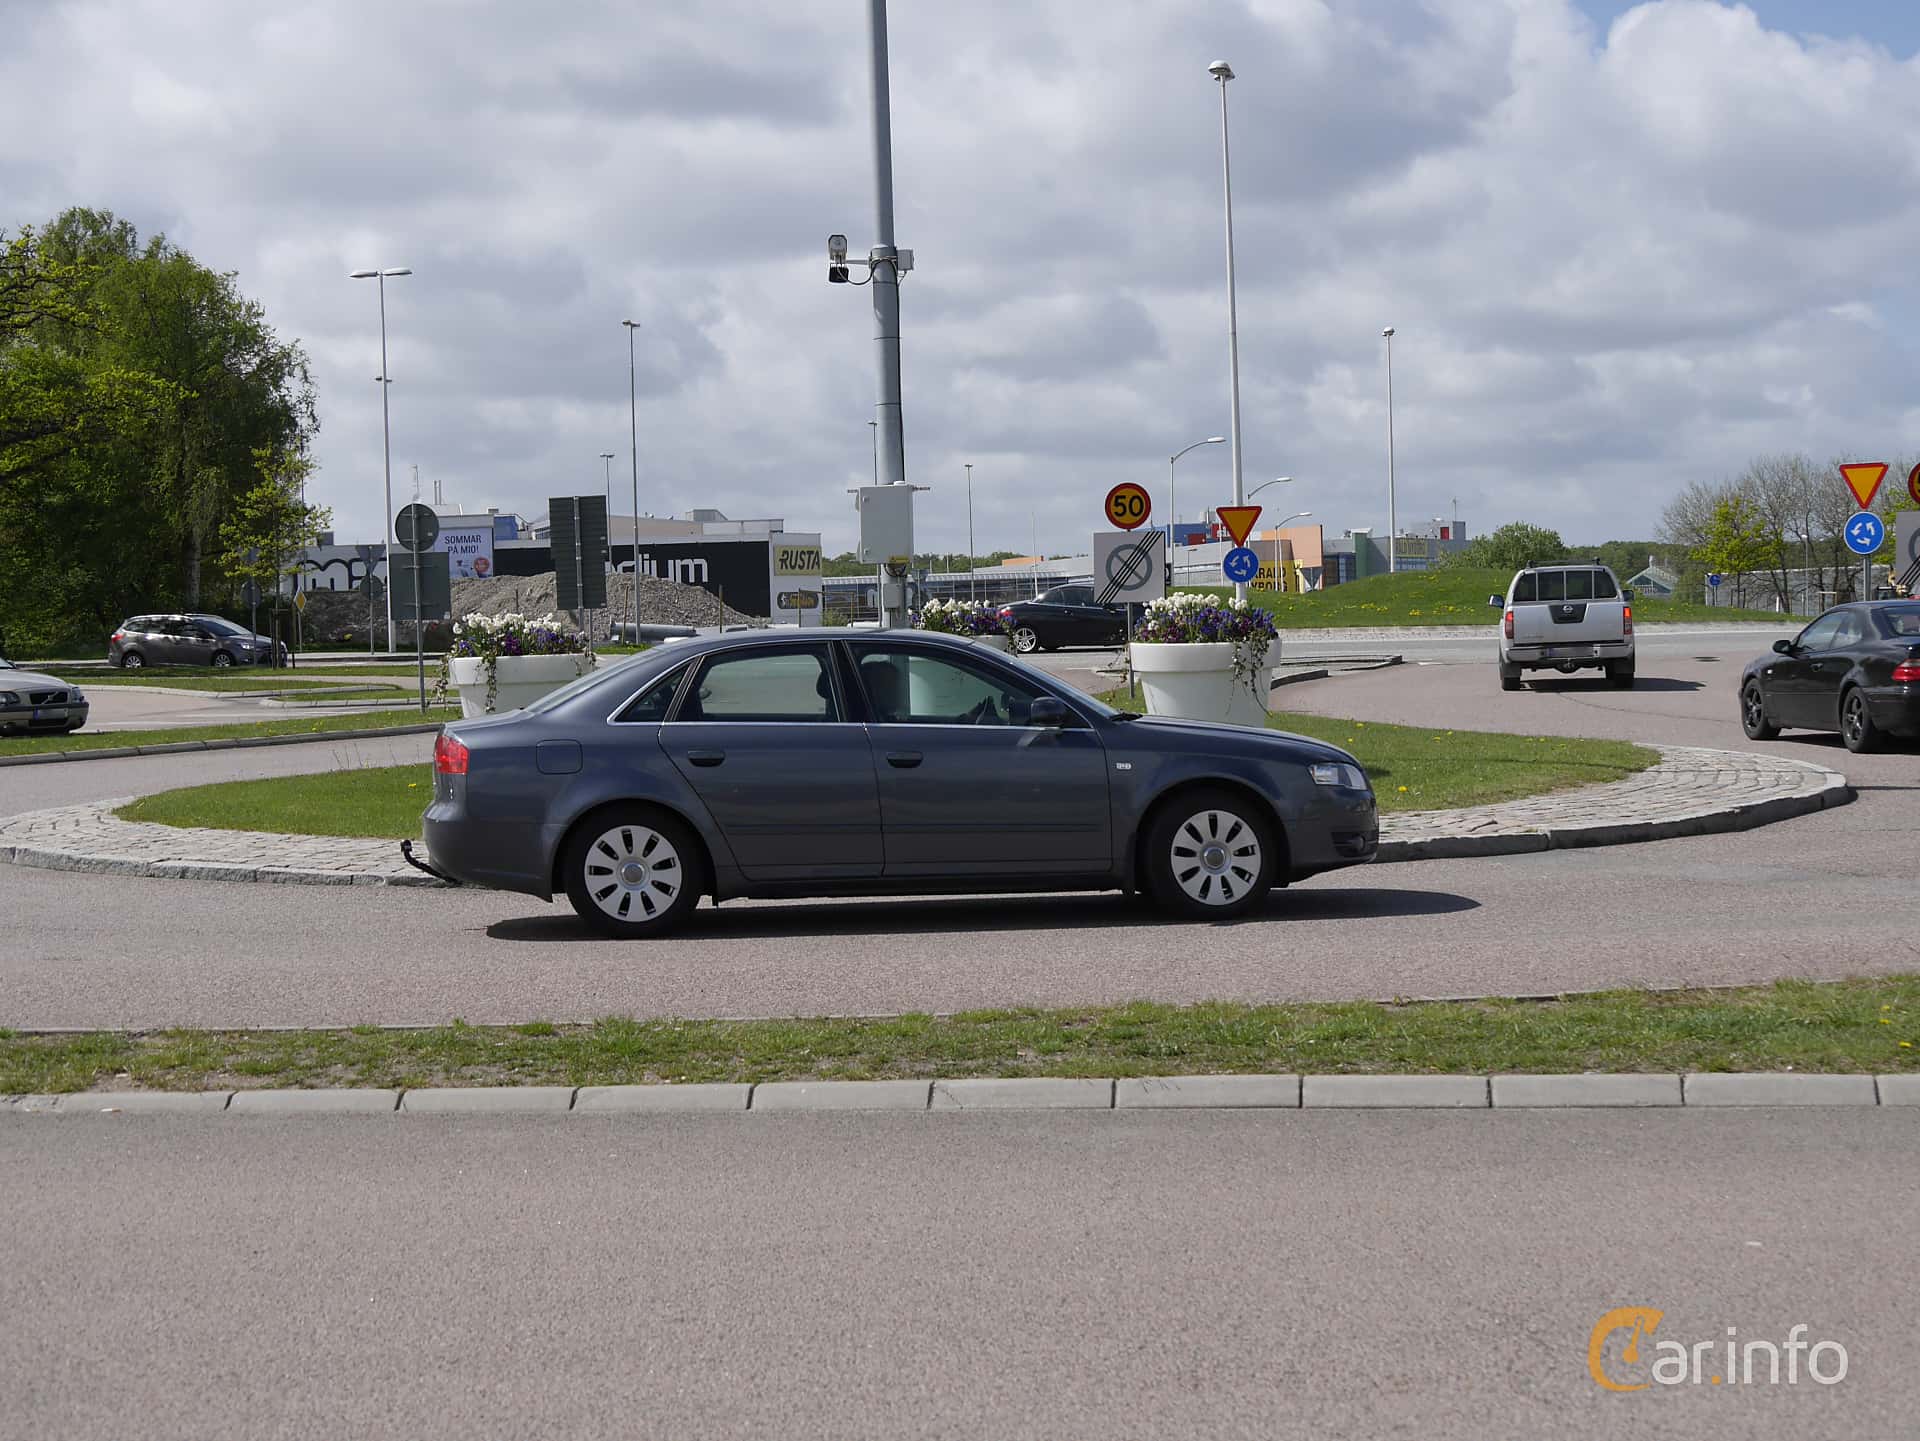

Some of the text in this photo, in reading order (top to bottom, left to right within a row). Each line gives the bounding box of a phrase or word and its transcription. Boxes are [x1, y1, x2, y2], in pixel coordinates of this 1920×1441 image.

[1113, 495, 1144, 517] 50
[444, 535, 482, 544] SOMMAR
[779, 550, 821, 570] RUSTA
